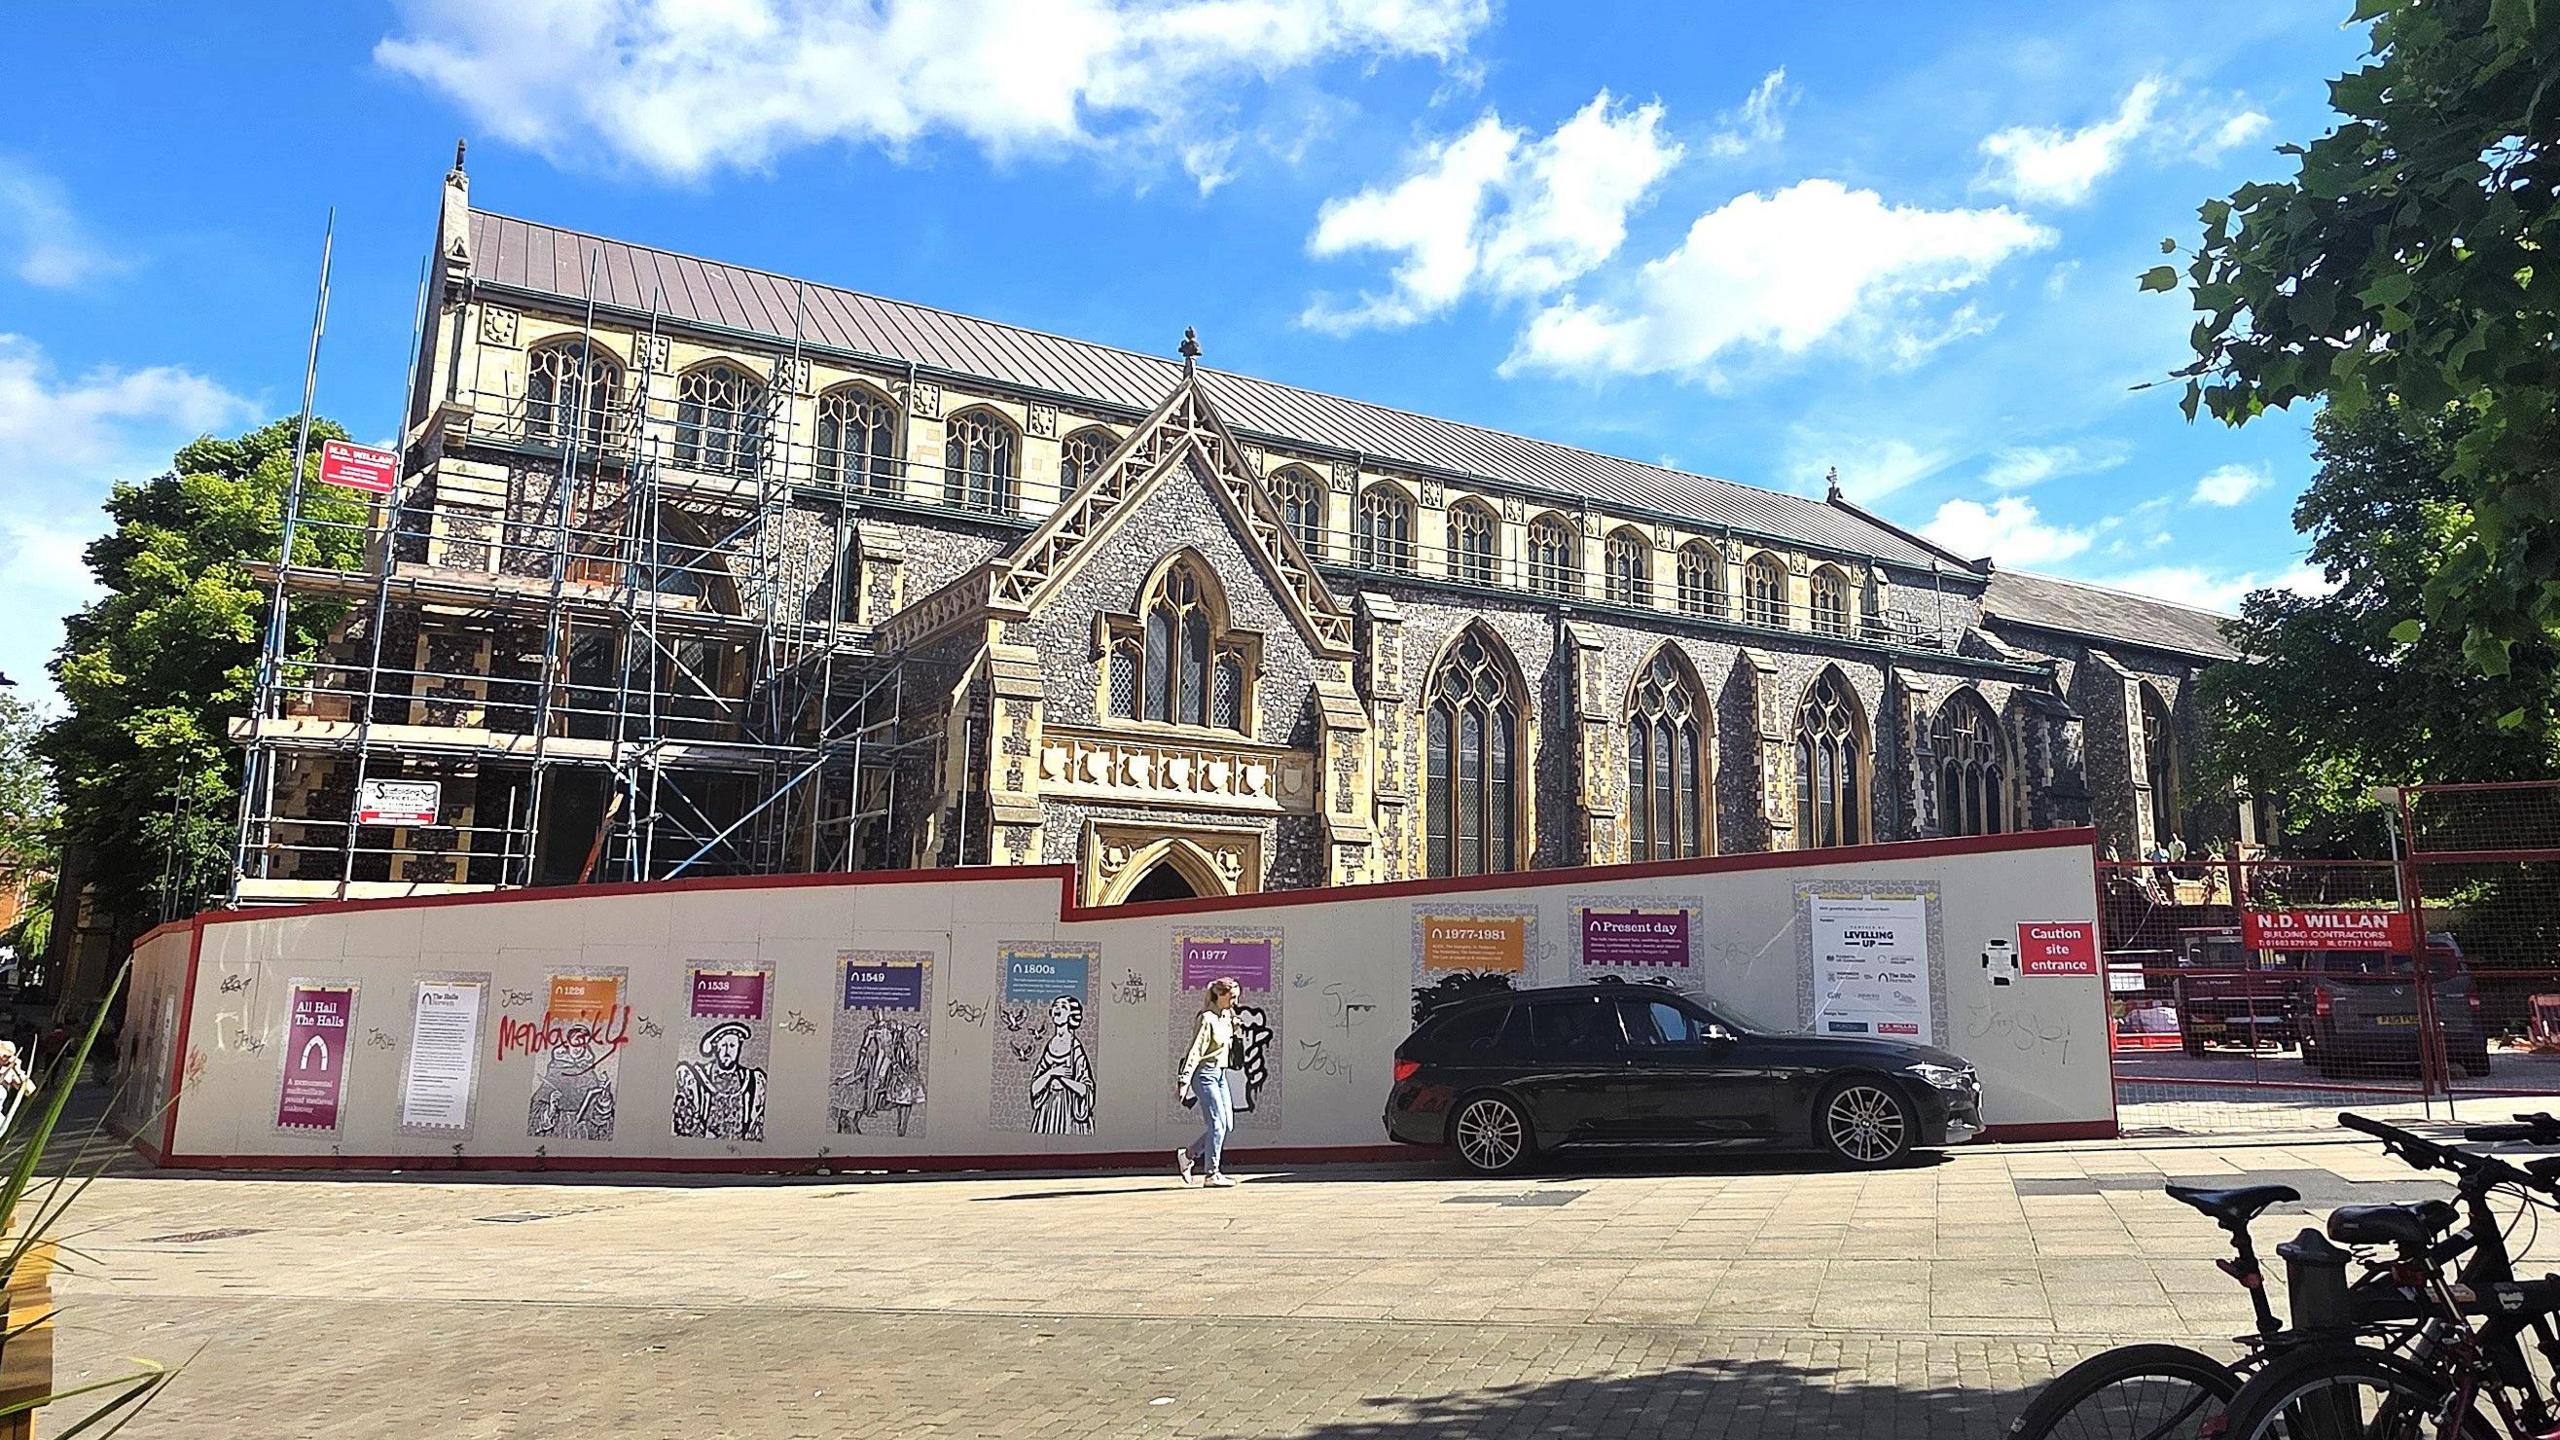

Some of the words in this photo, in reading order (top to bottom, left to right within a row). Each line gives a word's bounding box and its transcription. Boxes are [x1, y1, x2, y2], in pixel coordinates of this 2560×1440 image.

[353, 450, 394, 465] WILLAN
[2257, 915, 2299, 928] N.D.
[2304, 915, 2389, 928] WILLAN
[1603, 922, 1651, 932] Present
[1654, 922, 1677, 935] day
[2031, 928, 2081, 939] Caution
[1445, 929, 1506, 940] 1977-1981
[1844, 931, 1894, 939] LEVELLING
[2263, 931, 2308, 939] BUILDING
[2311, 931, 2386, 939] CONTRACTORS
[1862, 940, 1876, 948] UP
[2046, 943, 2070, 955] site
[1201, 951, 1228, 961] 1977
[1024, 962, 1055, 974] 1800s
[2031, 960, 2087, 970] entrance
[861, 973, 885, 982] 1549
[296, 1002, 312, 1013] All
[315, 1002, 337, 1013] Hail
[295, 1015, 314, 1026] The
[317, 1015, 344, 1027] Halls
